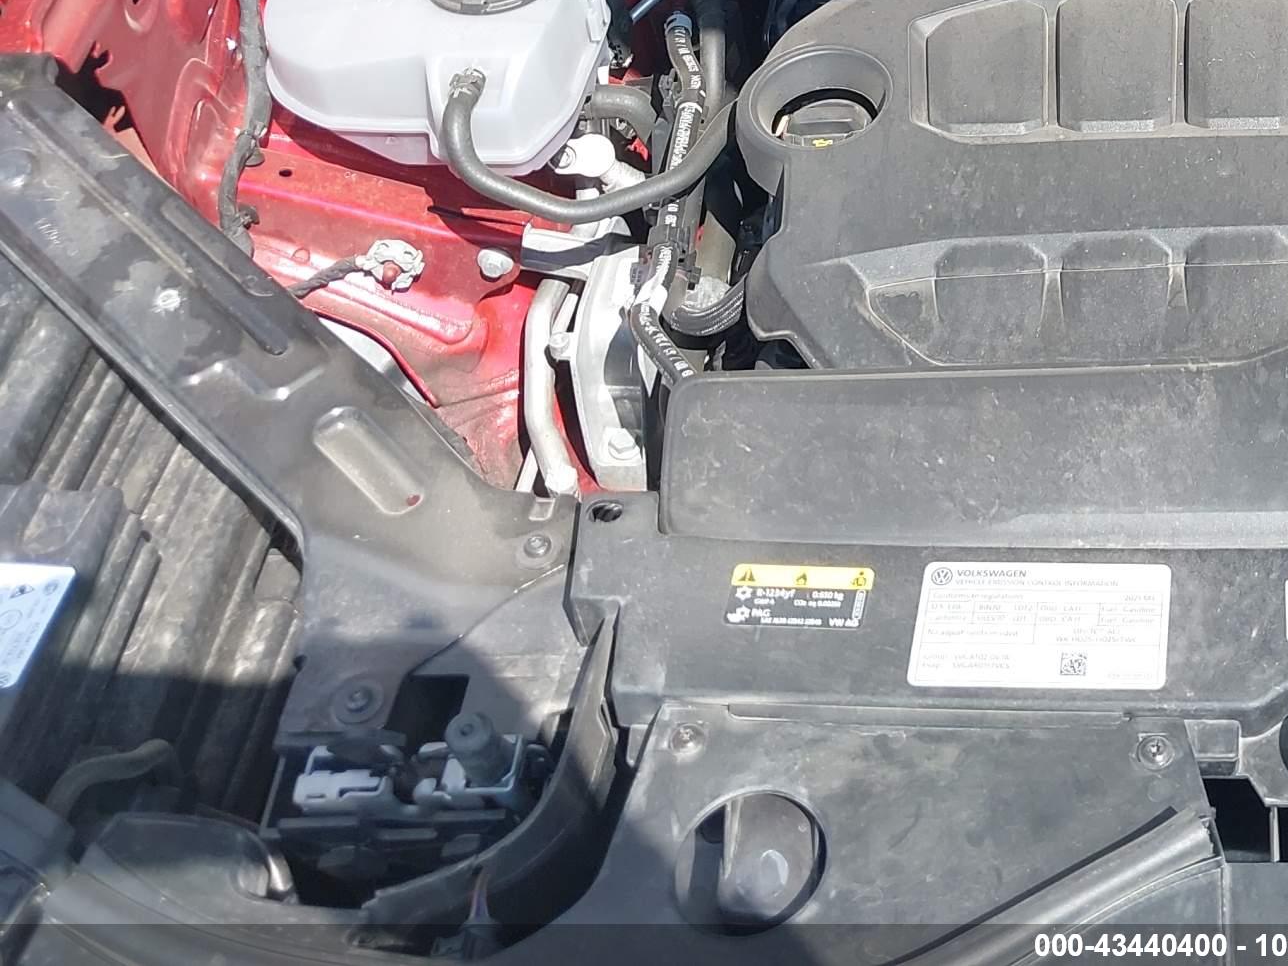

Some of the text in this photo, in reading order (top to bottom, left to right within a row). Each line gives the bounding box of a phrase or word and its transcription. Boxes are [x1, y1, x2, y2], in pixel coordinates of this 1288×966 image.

[957, 569, 1027, 577] VOLKSWAGEN
[751, 608, 771, 617] PAG
[829, 618, 844, 627] VW
